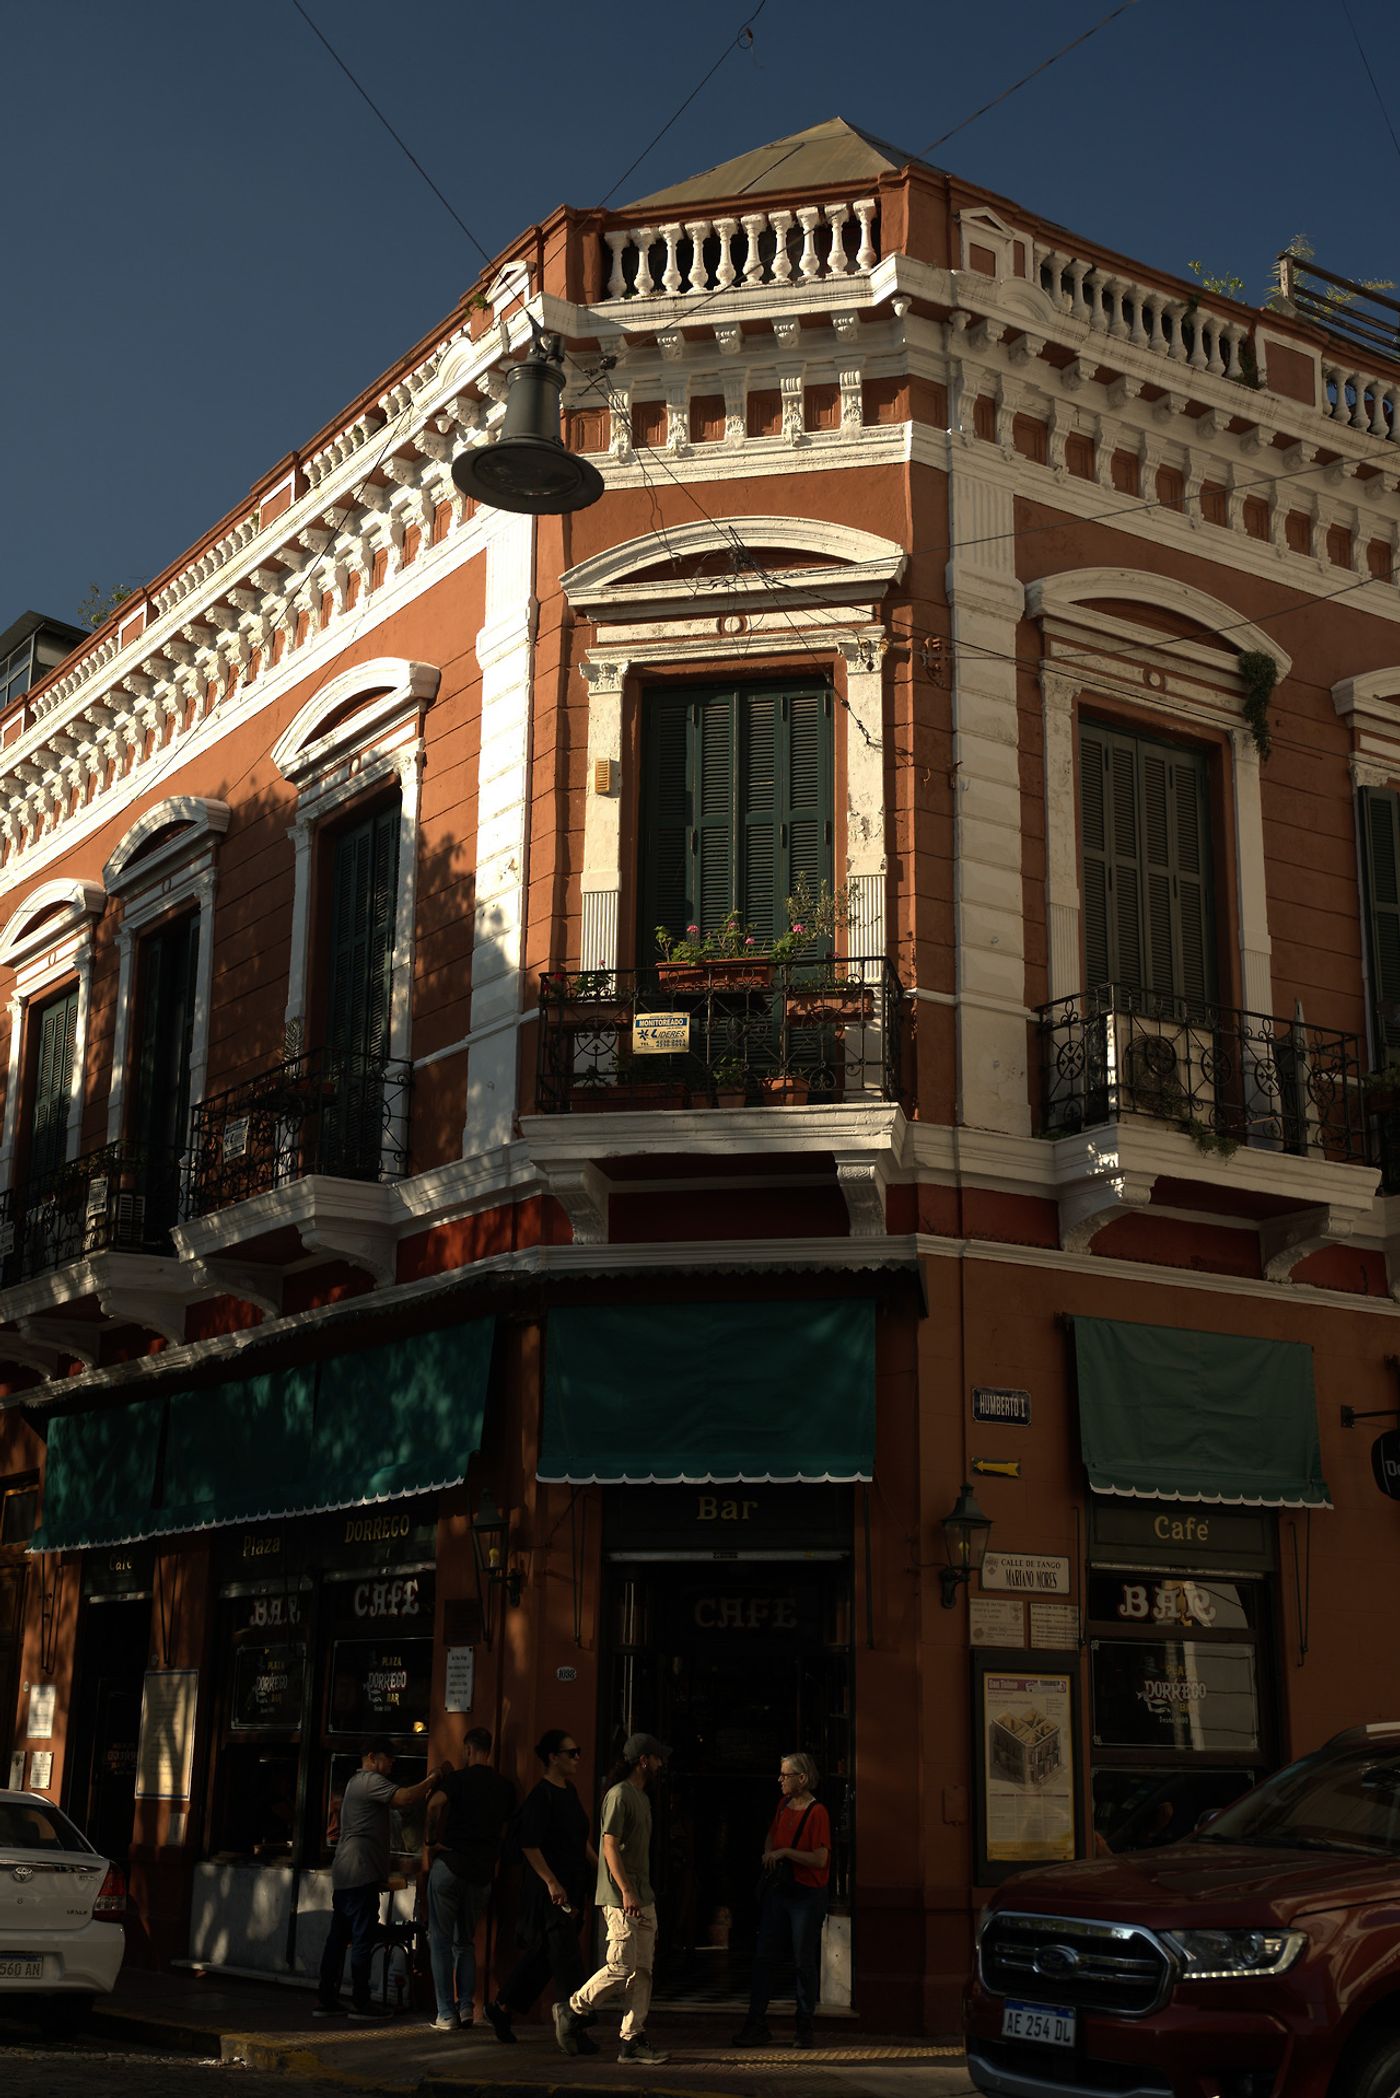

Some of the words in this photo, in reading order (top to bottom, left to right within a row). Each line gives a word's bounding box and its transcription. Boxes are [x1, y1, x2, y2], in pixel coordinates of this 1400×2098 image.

[979, 1394, 1019, 1417] HUMBERTO
[696, 1496, 759, 1521] Bar
[344, 1514, 411, 1544] DORREGO
[1154, 1514, 1210, 1541] Café
[242, 1536, 281, 1558] Plaza
[1119, 1584, 1217, 1627] BAR
[1144, 1680, 1207, 1702] DORREGO
[1007, 2012, 1022, 2034] AE
[1026, 2015, 1050, 2039] 254
[1055, 2020, 1071, 2042] DL
